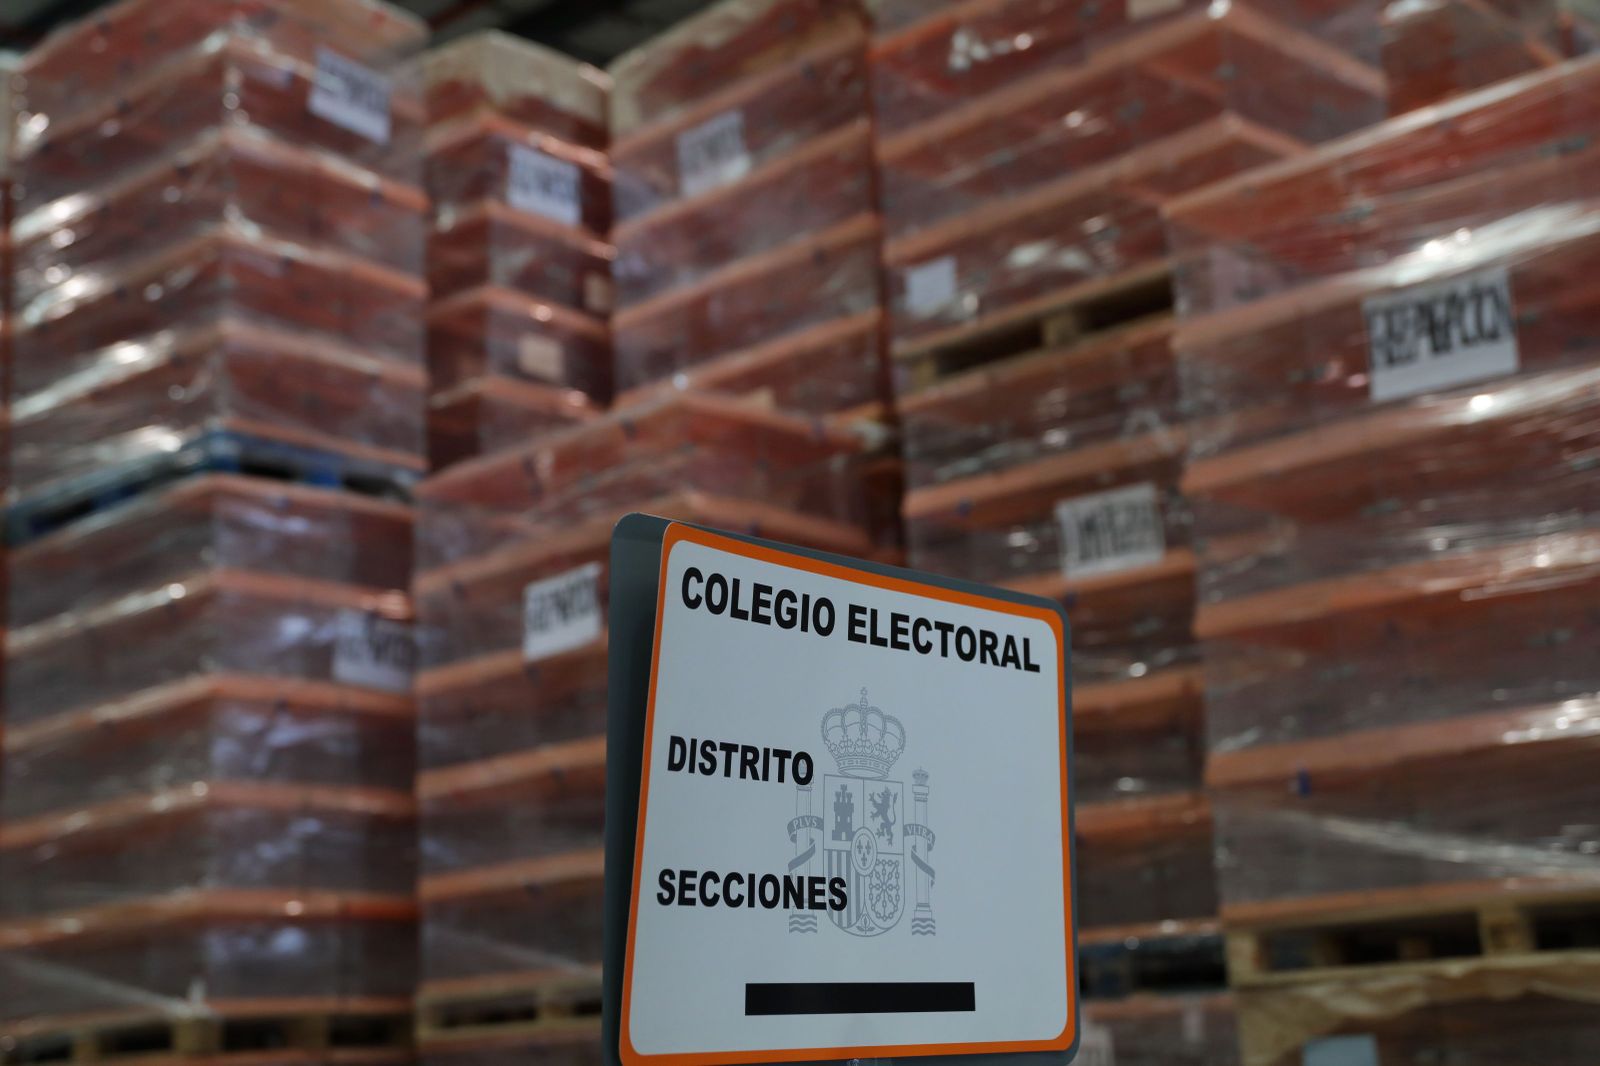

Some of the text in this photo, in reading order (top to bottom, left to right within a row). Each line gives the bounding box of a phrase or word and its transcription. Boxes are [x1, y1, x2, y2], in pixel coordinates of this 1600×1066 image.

[682, 567, 835, 636] COLEGIO
[848, 604, 1040, 672] ELECTORAL
[667, 736, 814, 786] DISTRITO
[657, 868, 847, 911] SECCIONES
